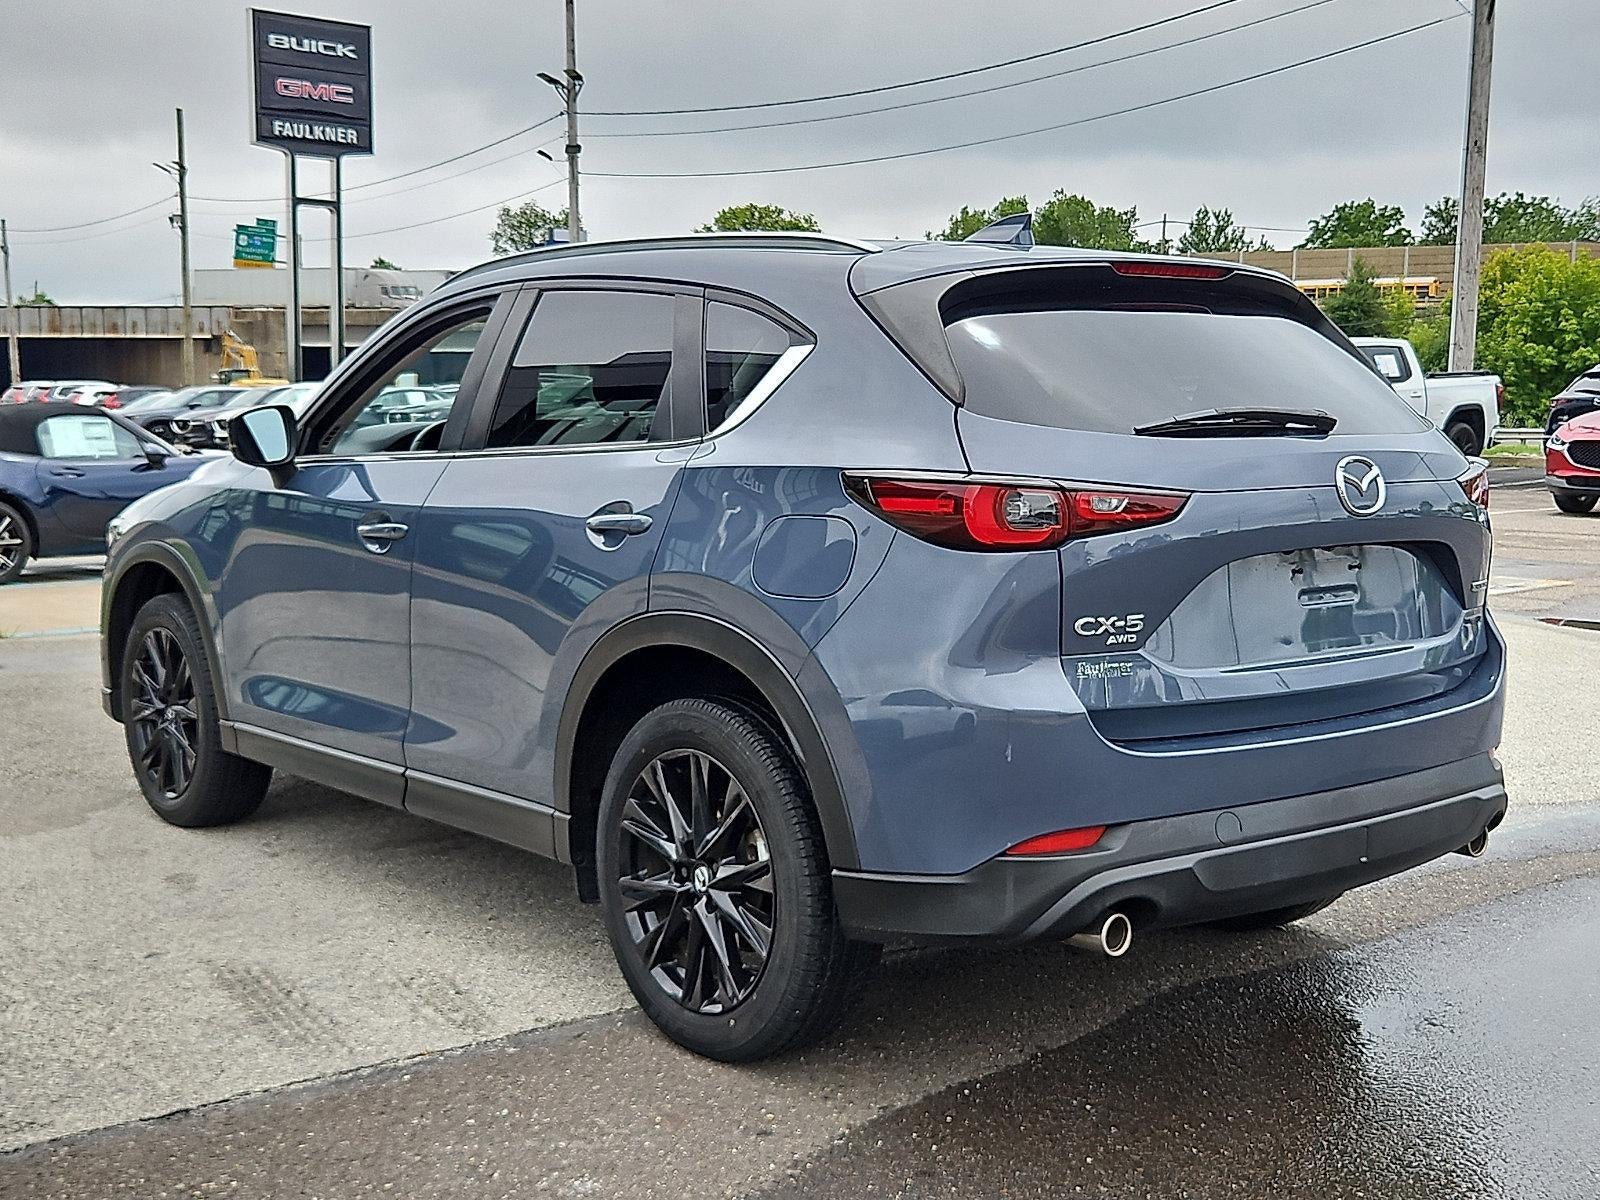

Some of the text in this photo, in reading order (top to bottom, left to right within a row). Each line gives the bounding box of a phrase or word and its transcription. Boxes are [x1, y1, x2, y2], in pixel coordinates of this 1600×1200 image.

[268, 33, 358, 59] BUICK
[275, 78, 354, 104] GMC
[272, 120, 358, 144] FAULKNER
[1074, 614, 1145, 636] CX-5
[1106, 634, 1137, 645] AWD
